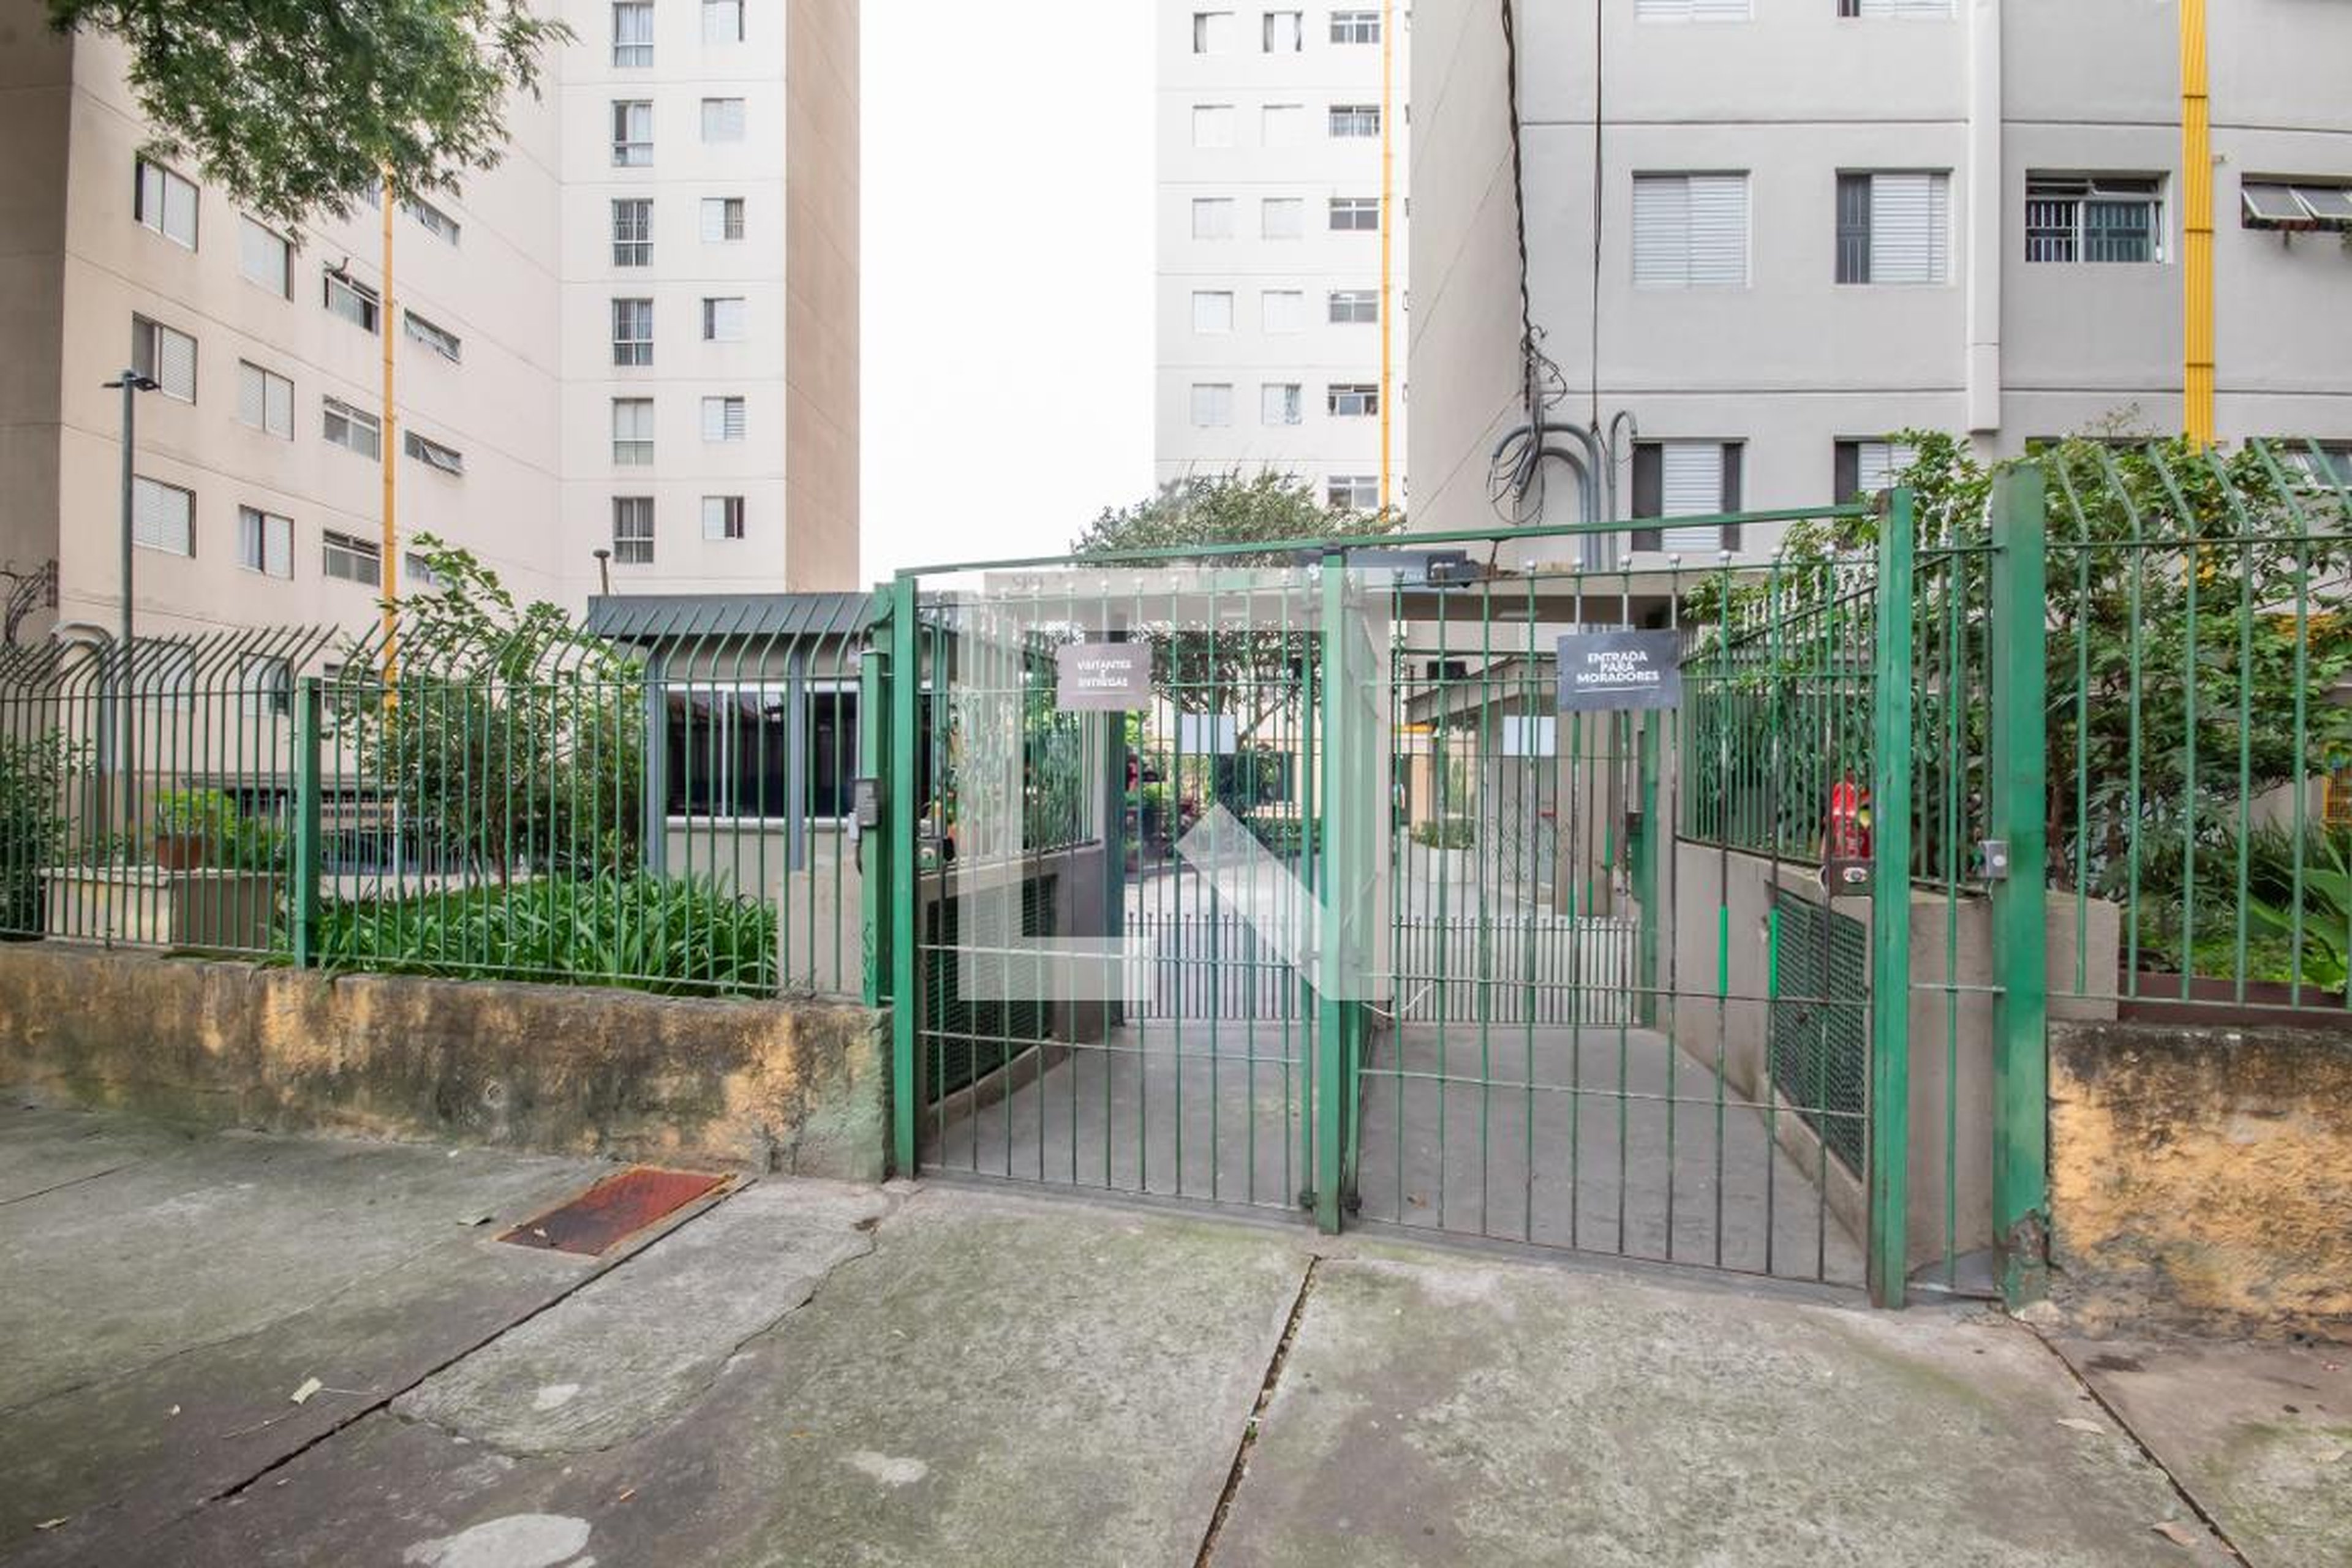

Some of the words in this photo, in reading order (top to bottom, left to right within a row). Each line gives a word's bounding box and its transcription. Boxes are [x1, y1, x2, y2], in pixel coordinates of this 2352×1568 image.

[1587, 650, 1648, 663] ENTRADA
[1600, 662, 1635, 673] PARA
[1576, 671, 1660, 684] MORADORES
